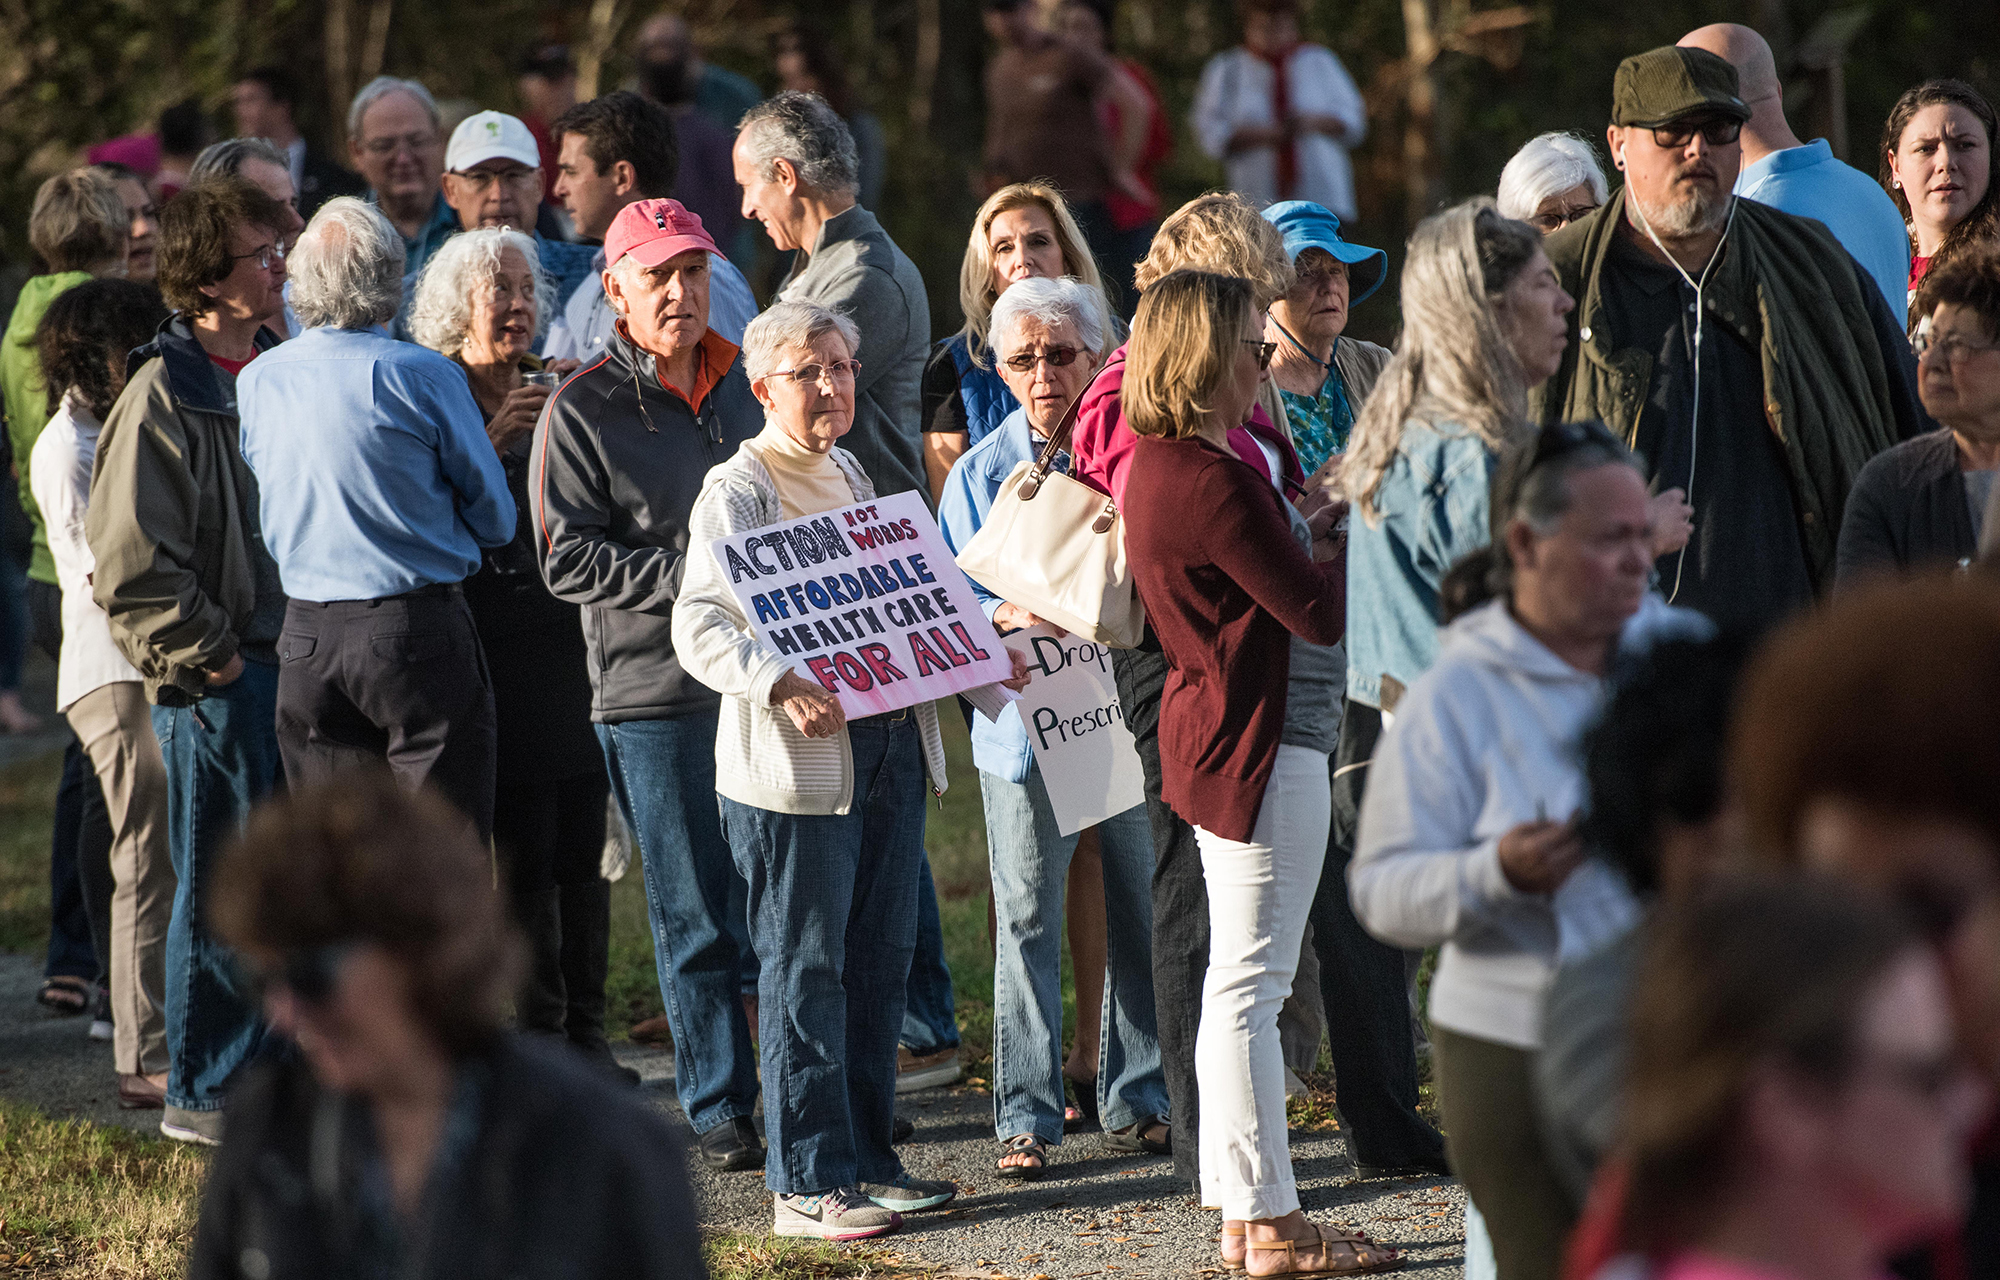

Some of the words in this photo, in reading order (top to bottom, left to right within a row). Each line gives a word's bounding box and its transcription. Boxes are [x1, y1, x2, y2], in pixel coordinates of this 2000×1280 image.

[725, 516, 852, 583] ACTION
[842, 505, 878, 527] NOT
[848, 518, 919, 550] WORDS
[751, 553, 937, 624] AFFORDABLE
[769, 606, 886, 656] HEALTH
[884, 587, 958, 627] CARE
[803, 643, 908, 693] FOR
[907, 621, 991, 677] ALL
